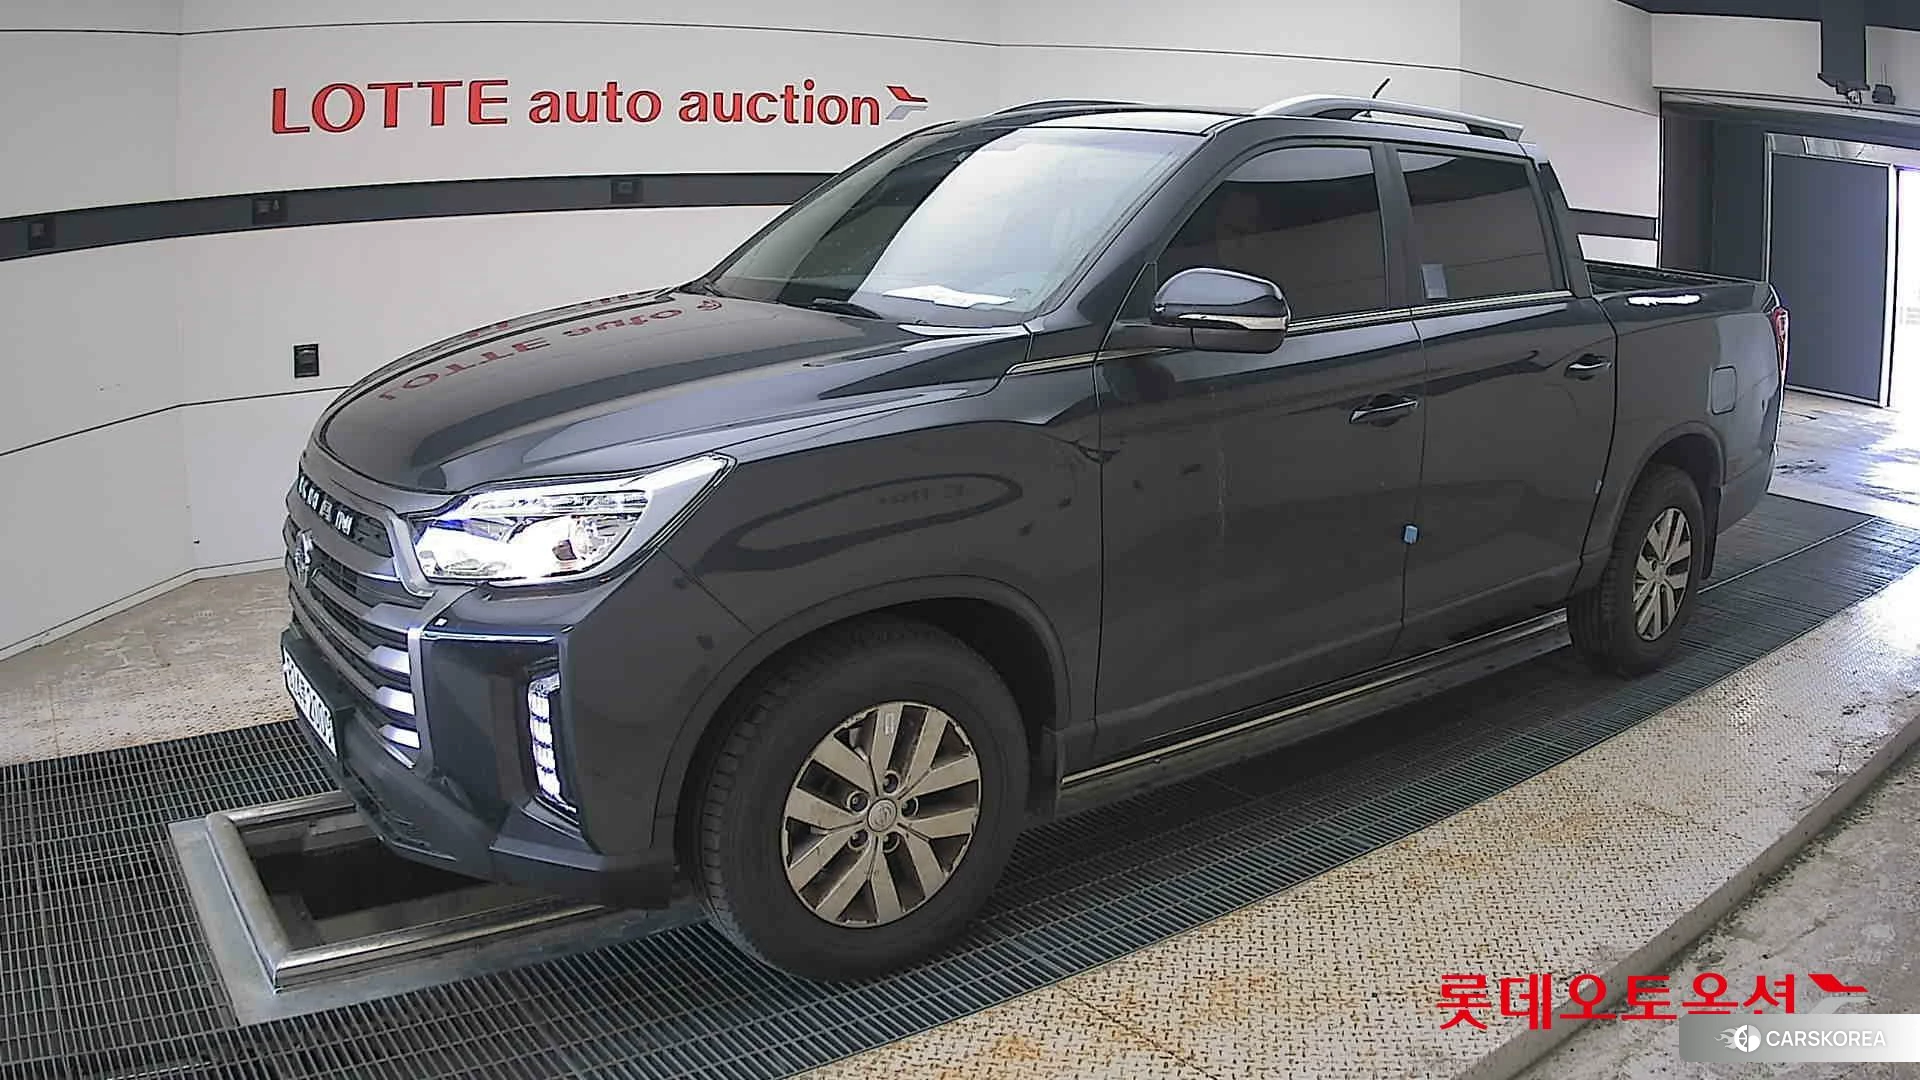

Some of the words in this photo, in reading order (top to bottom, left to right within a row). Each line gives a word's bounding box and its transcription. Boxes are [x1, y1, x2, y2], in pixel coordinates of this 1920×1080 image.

[272, 79, 509, 134] LOTTE
[528, 81, 662, 123] auto
[678, 78, 880, 126] auction
